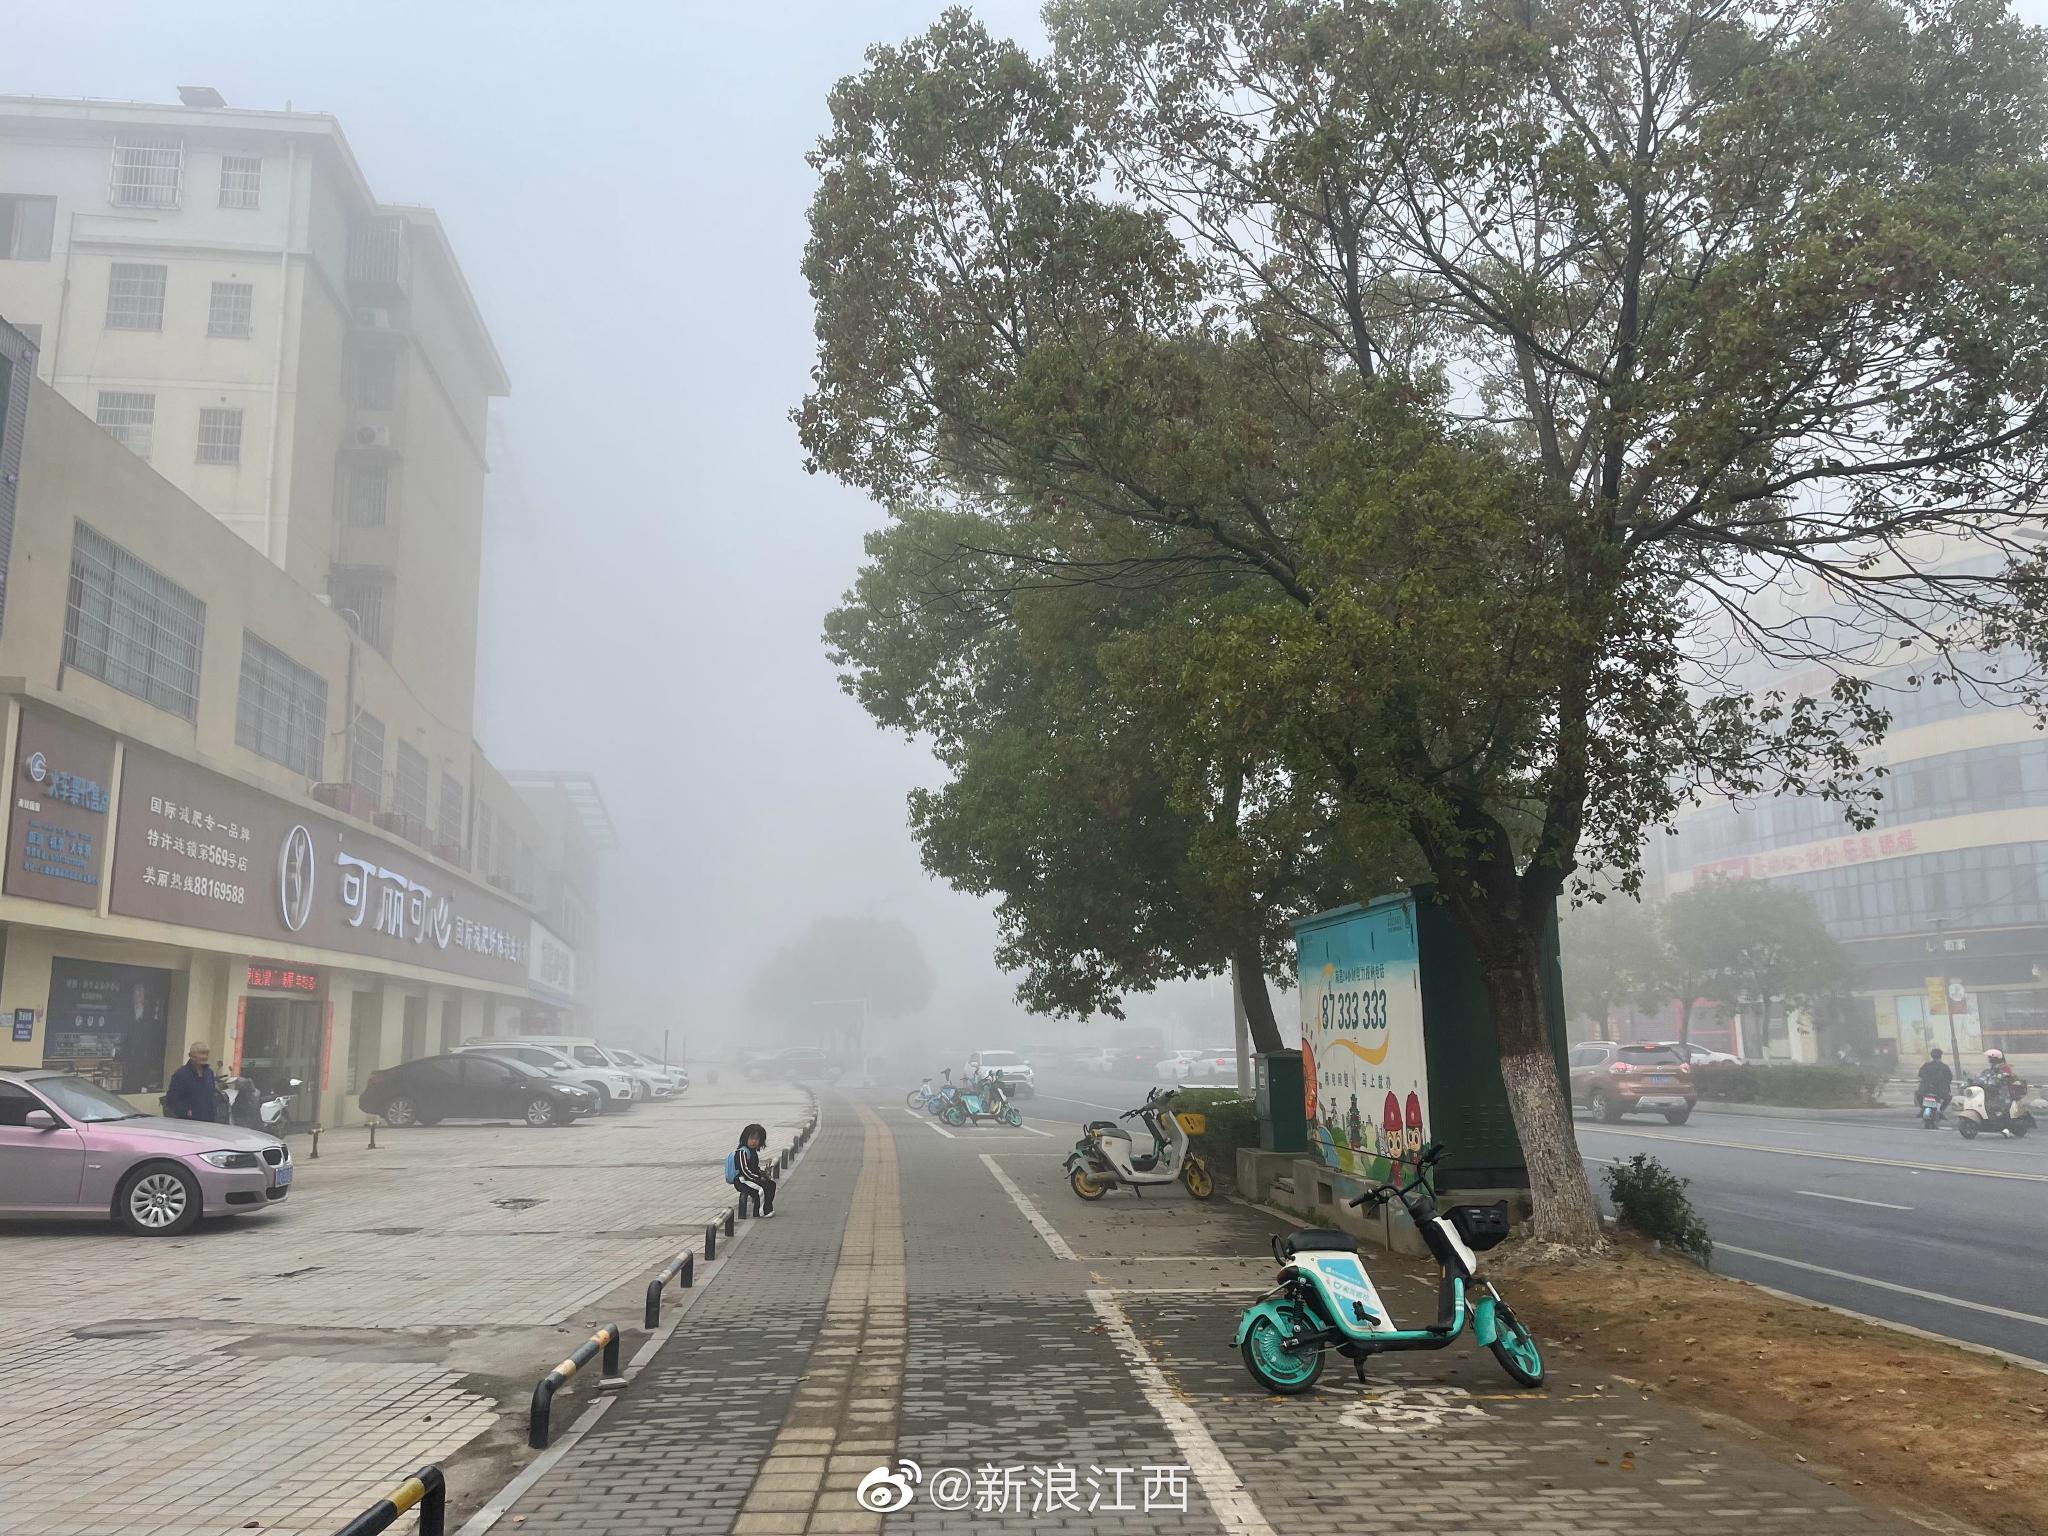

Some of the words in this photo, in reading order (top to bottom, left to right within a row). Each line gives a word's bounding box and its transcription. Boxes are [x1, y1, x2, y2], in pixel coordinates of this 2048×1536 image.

[150, 796, 252, 844] 国际减肥专一品牌
[146, 828, 249, 873] 特许连锁第569号店
[143, 865, 246, 905] 美丽热线88169588
[337, 851, 453, 950] 可丽可心
